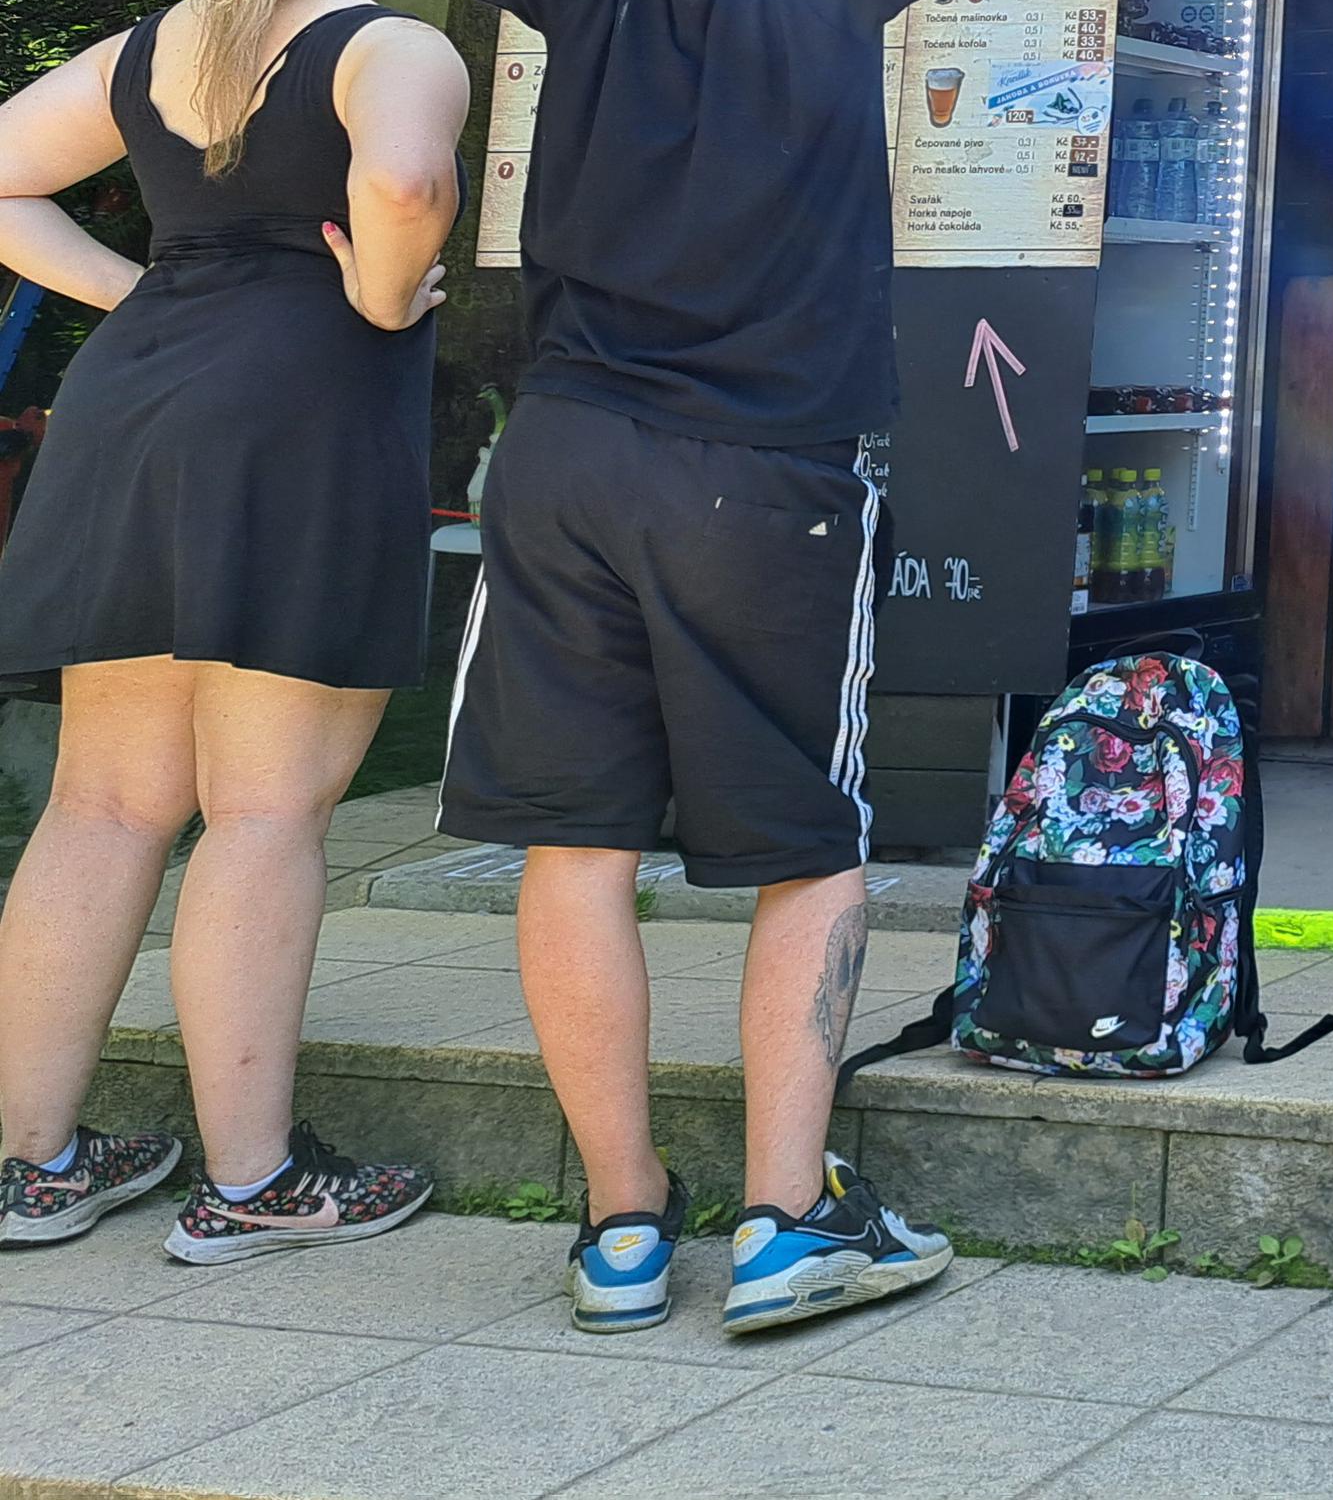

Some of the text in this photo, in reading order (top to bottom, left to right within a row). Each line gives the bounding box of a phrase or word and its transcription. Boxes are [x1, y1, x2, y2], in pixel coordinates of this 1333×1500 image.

[925, 12, 958, 23] Točená
[960, 12, 1008, 23] malinovka
[1065, 10, 1077, 21] Kč
[923, 38, 988, 50] Točená kofola
[1006, 110, 1034, 123] 120,-
[914, 136, 985, 150] Čepované pivo
[911, 194, 943, 205] Svařák
[1052, 194, 1065, 204] Kč
[907, 221, 937, 231] Horká
[938, 220, 982, 231] čokoláda
[1050, 220, 1063, 230] Kč
